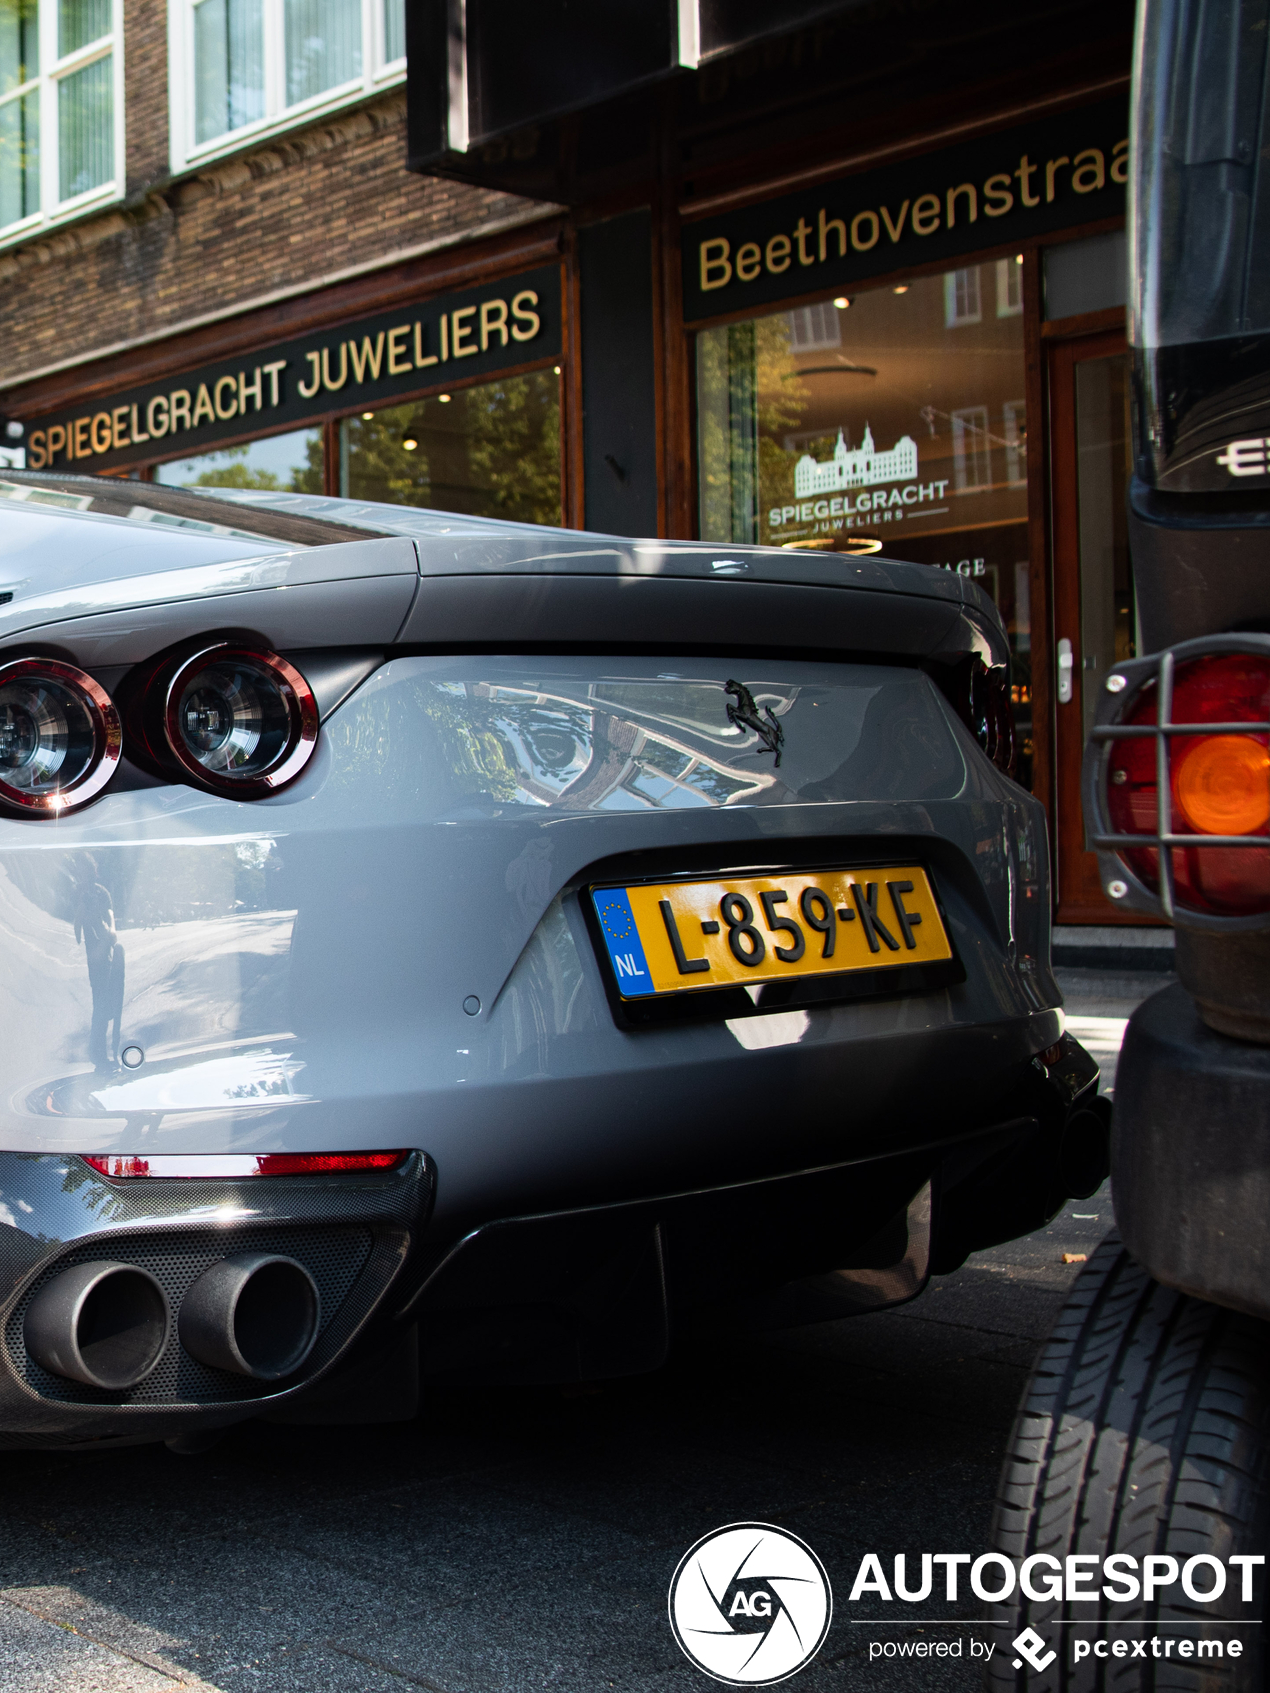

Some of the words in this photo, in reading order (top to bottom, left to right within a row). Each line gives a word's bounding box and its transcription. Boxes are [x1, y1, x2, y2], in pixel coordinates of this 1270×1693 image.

[28, 360, 287, 469] SPIEGELGRACHT
[297, 290, 541, 399] JUWELIERS
[768, 479, 950, 527] SPIEGELGRACHT
[812, 509, 904, 534] JUWELIERS
[658, 880, 922, 975] L-859-KF
[614, 953, 645, 978] NL
